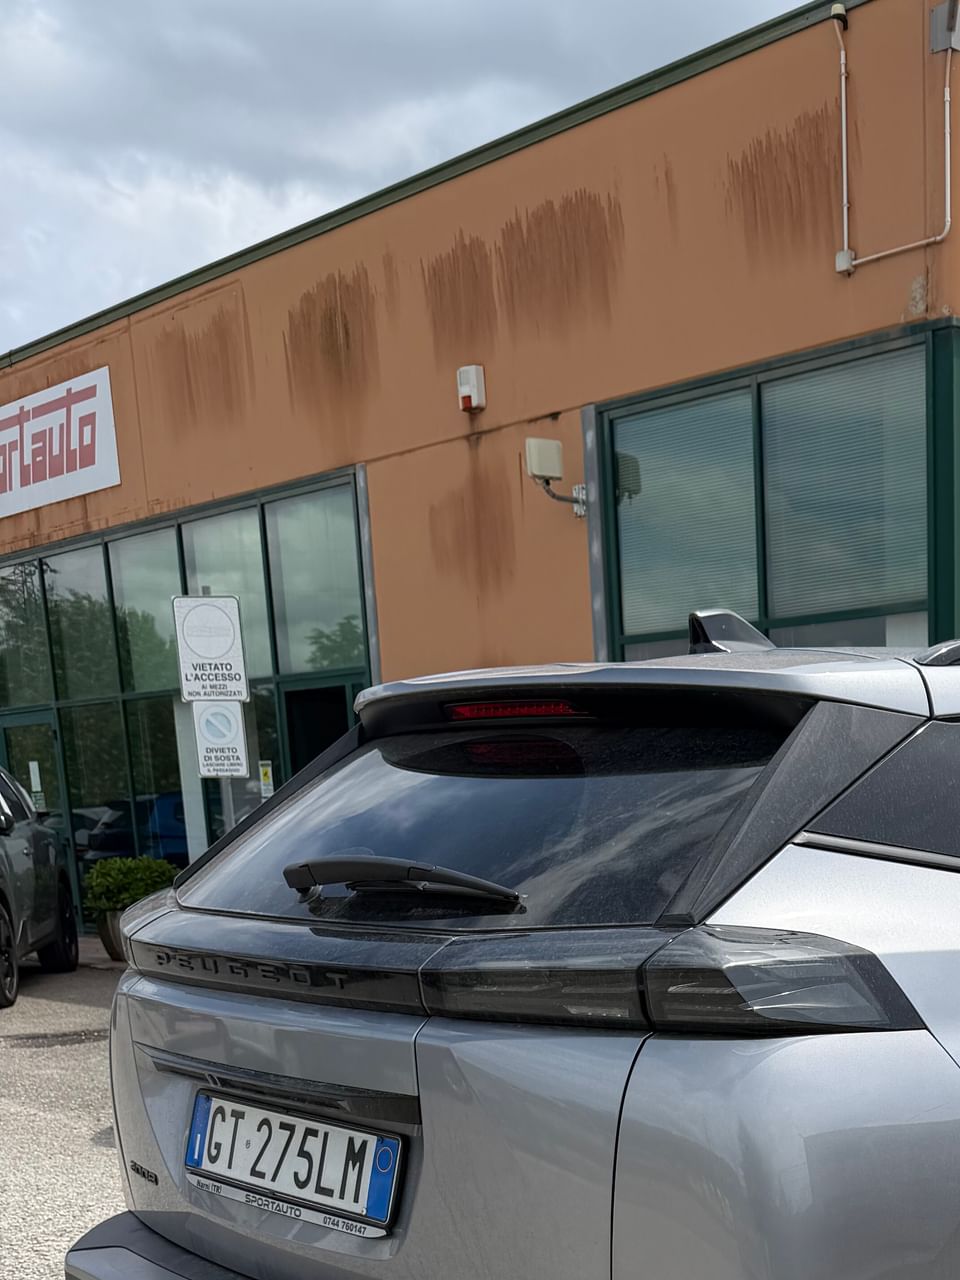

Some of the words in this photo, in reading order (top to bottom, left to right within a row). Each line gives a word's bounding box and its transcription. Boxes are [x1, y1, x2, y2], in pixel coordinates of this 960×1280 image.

[185, 673, 242, 681] L'ACCESSO
[192, 663, 232, 671] VIETATO
[156, 951, 348, 989] PEUGEOT
[207, 1105, 246, 1170] GT
[250, 1117, 369, 1204] 275LM
[197, 1179, 210, 1191] Narni
[211, 1183, 223, 1194] (TR)
[244, 1194, 302, 1217] SPORTAUTO
[323, 1215, 340, 1228] 0744
[341, 1220, 367, 1235] 760147
